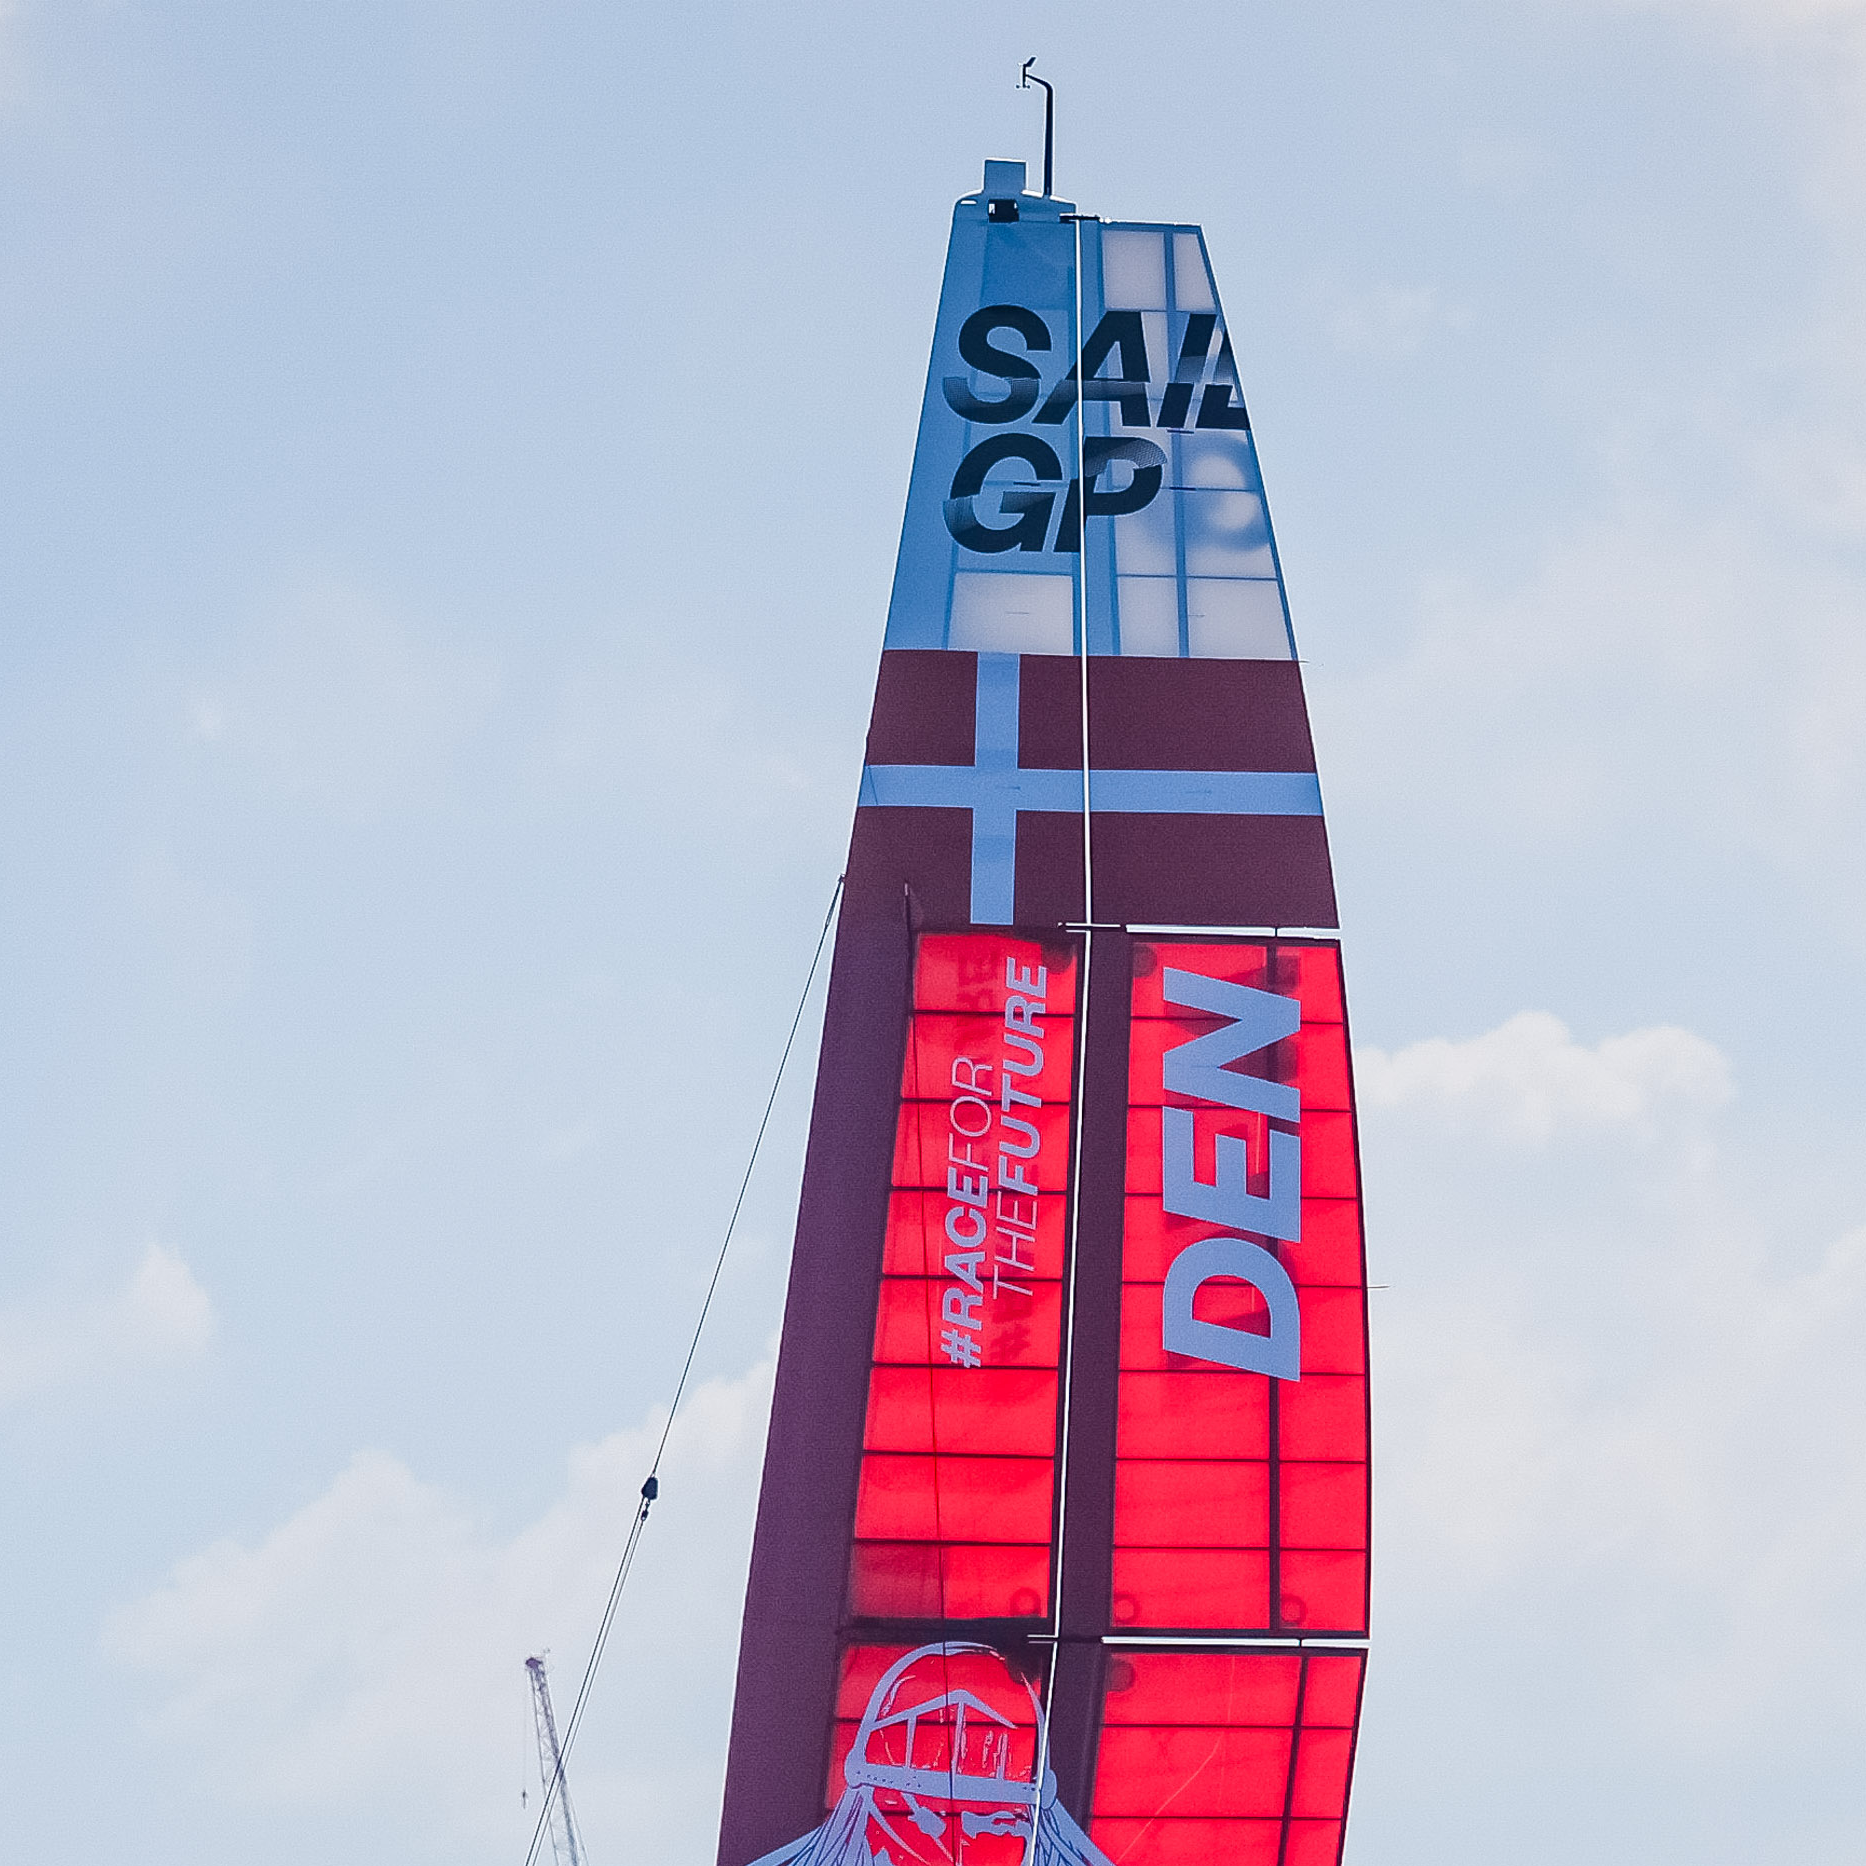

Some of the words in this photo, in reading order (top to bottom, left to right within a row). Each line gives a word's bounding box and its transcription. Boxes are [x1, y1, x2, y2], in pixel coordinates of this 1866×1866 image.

[942, 304, 1251, 430] SAIL
[942, 432, 1169, 554] GP
[1162, 966, 1301, 1382] DEN
